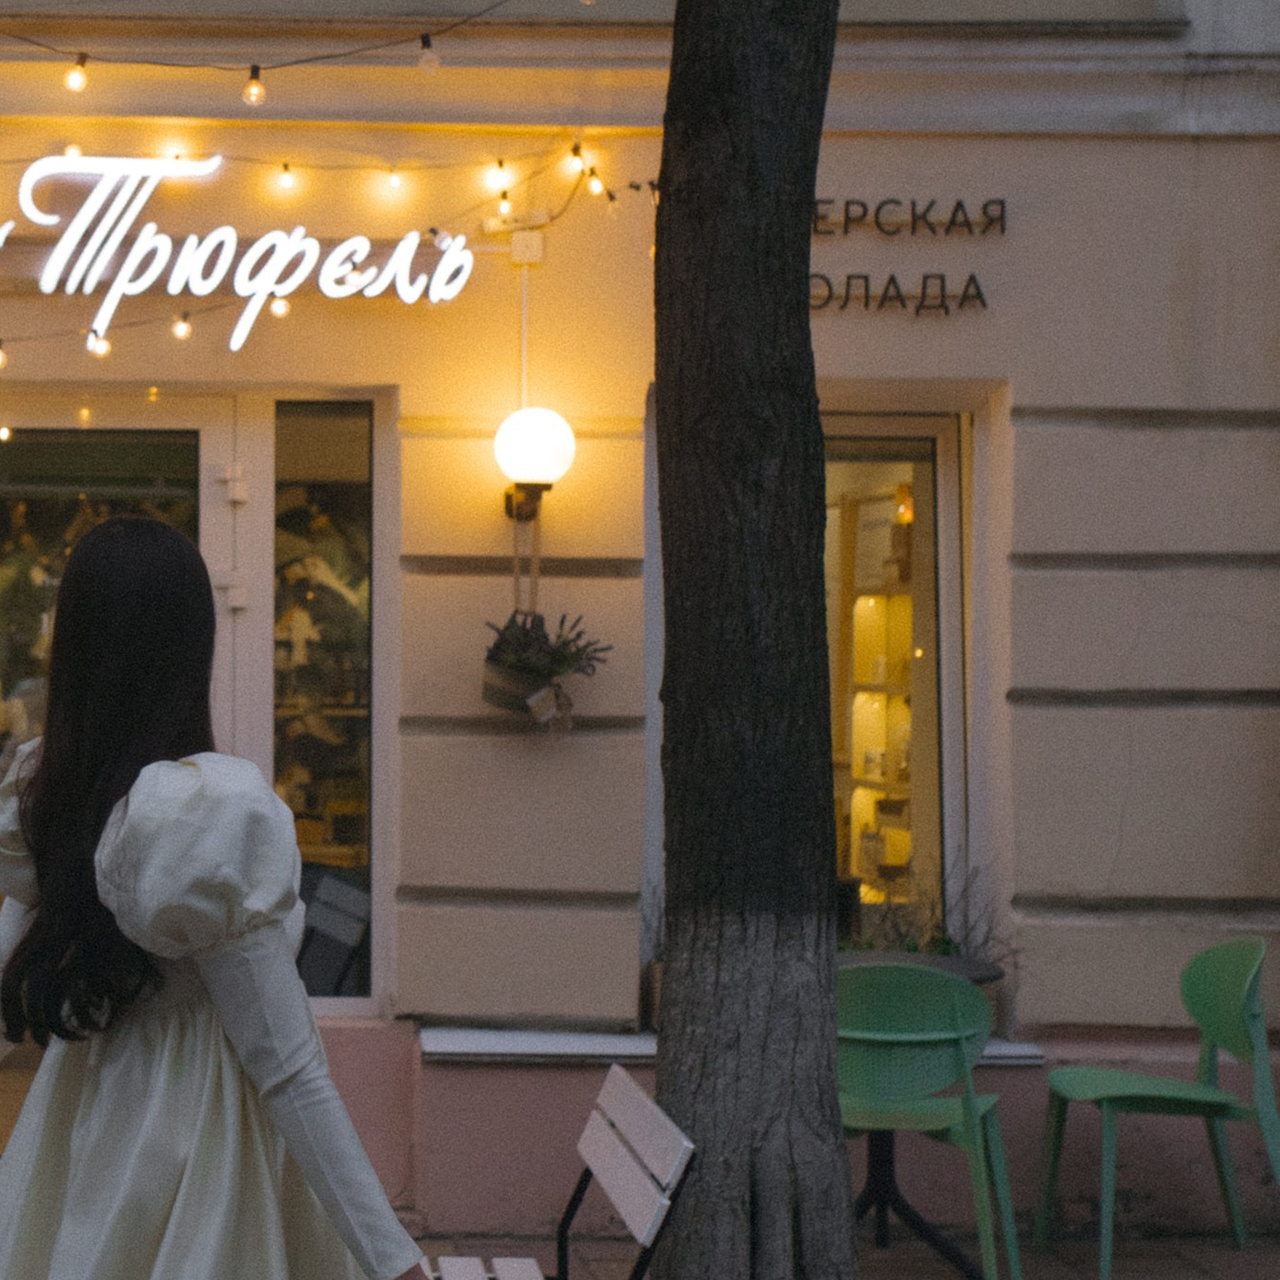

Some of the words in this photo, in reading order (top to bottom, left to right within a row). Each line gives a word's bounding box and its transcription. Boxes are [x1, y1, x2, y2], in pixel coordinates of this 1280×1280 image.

[812, 198, 1007, 236] ЕРСКАЯ
[18, 154, 475, 352] Трюфель
[809, 273, 988, 317] ОЛАДА
